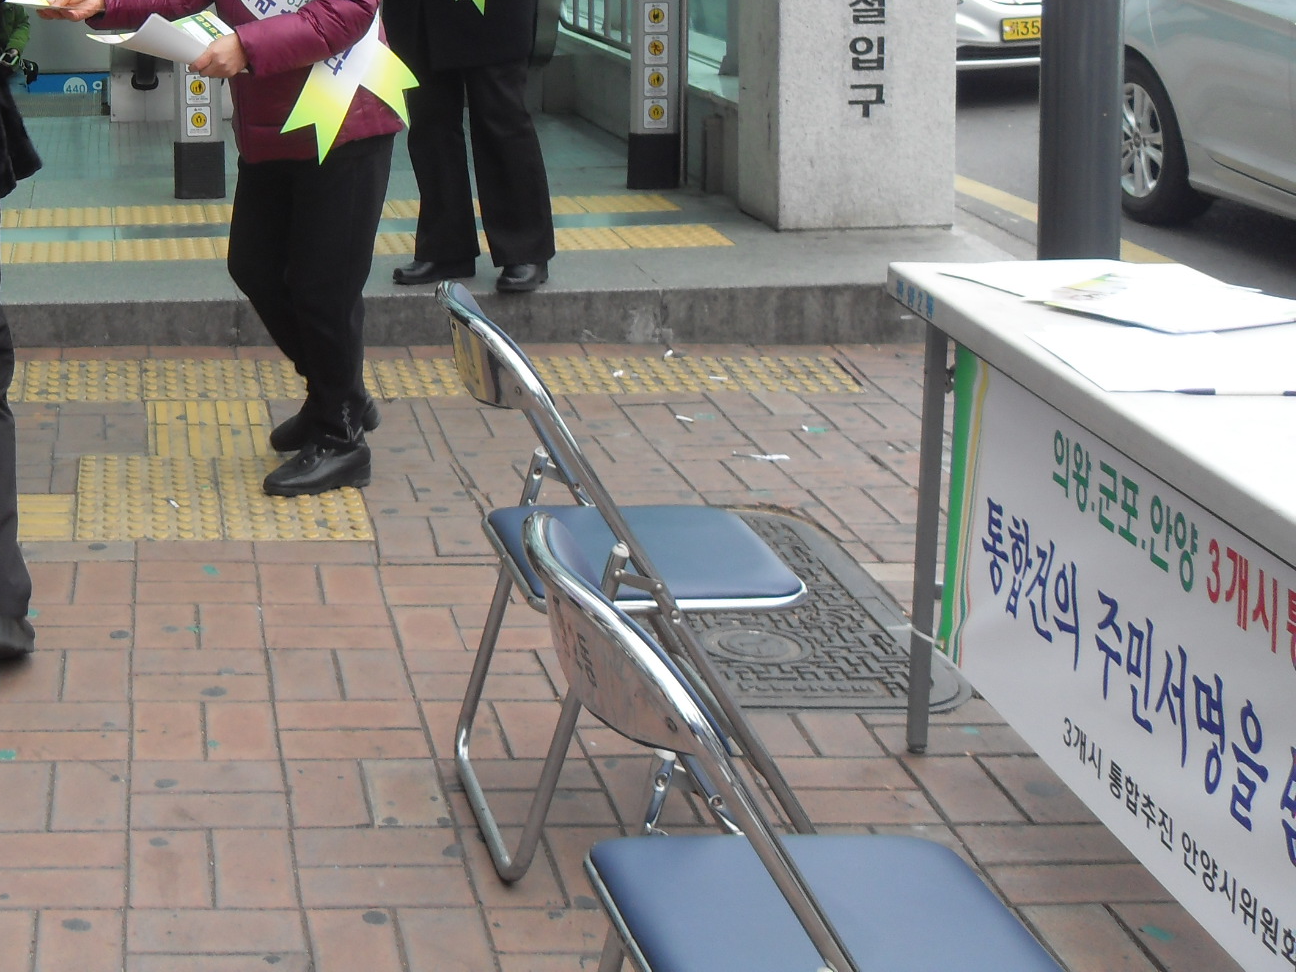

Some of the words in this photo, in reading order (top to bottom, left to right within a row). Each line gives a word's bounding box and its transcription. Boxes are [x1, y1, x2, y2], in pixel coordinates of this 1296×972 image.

[982, 496, 1080, 671] 통합건의
[1095, 588, 1270, 832] 주민서명을
[1062, 717, 1103, 780] 3개시
[1108, 759, 1174, 853] 통합추진
